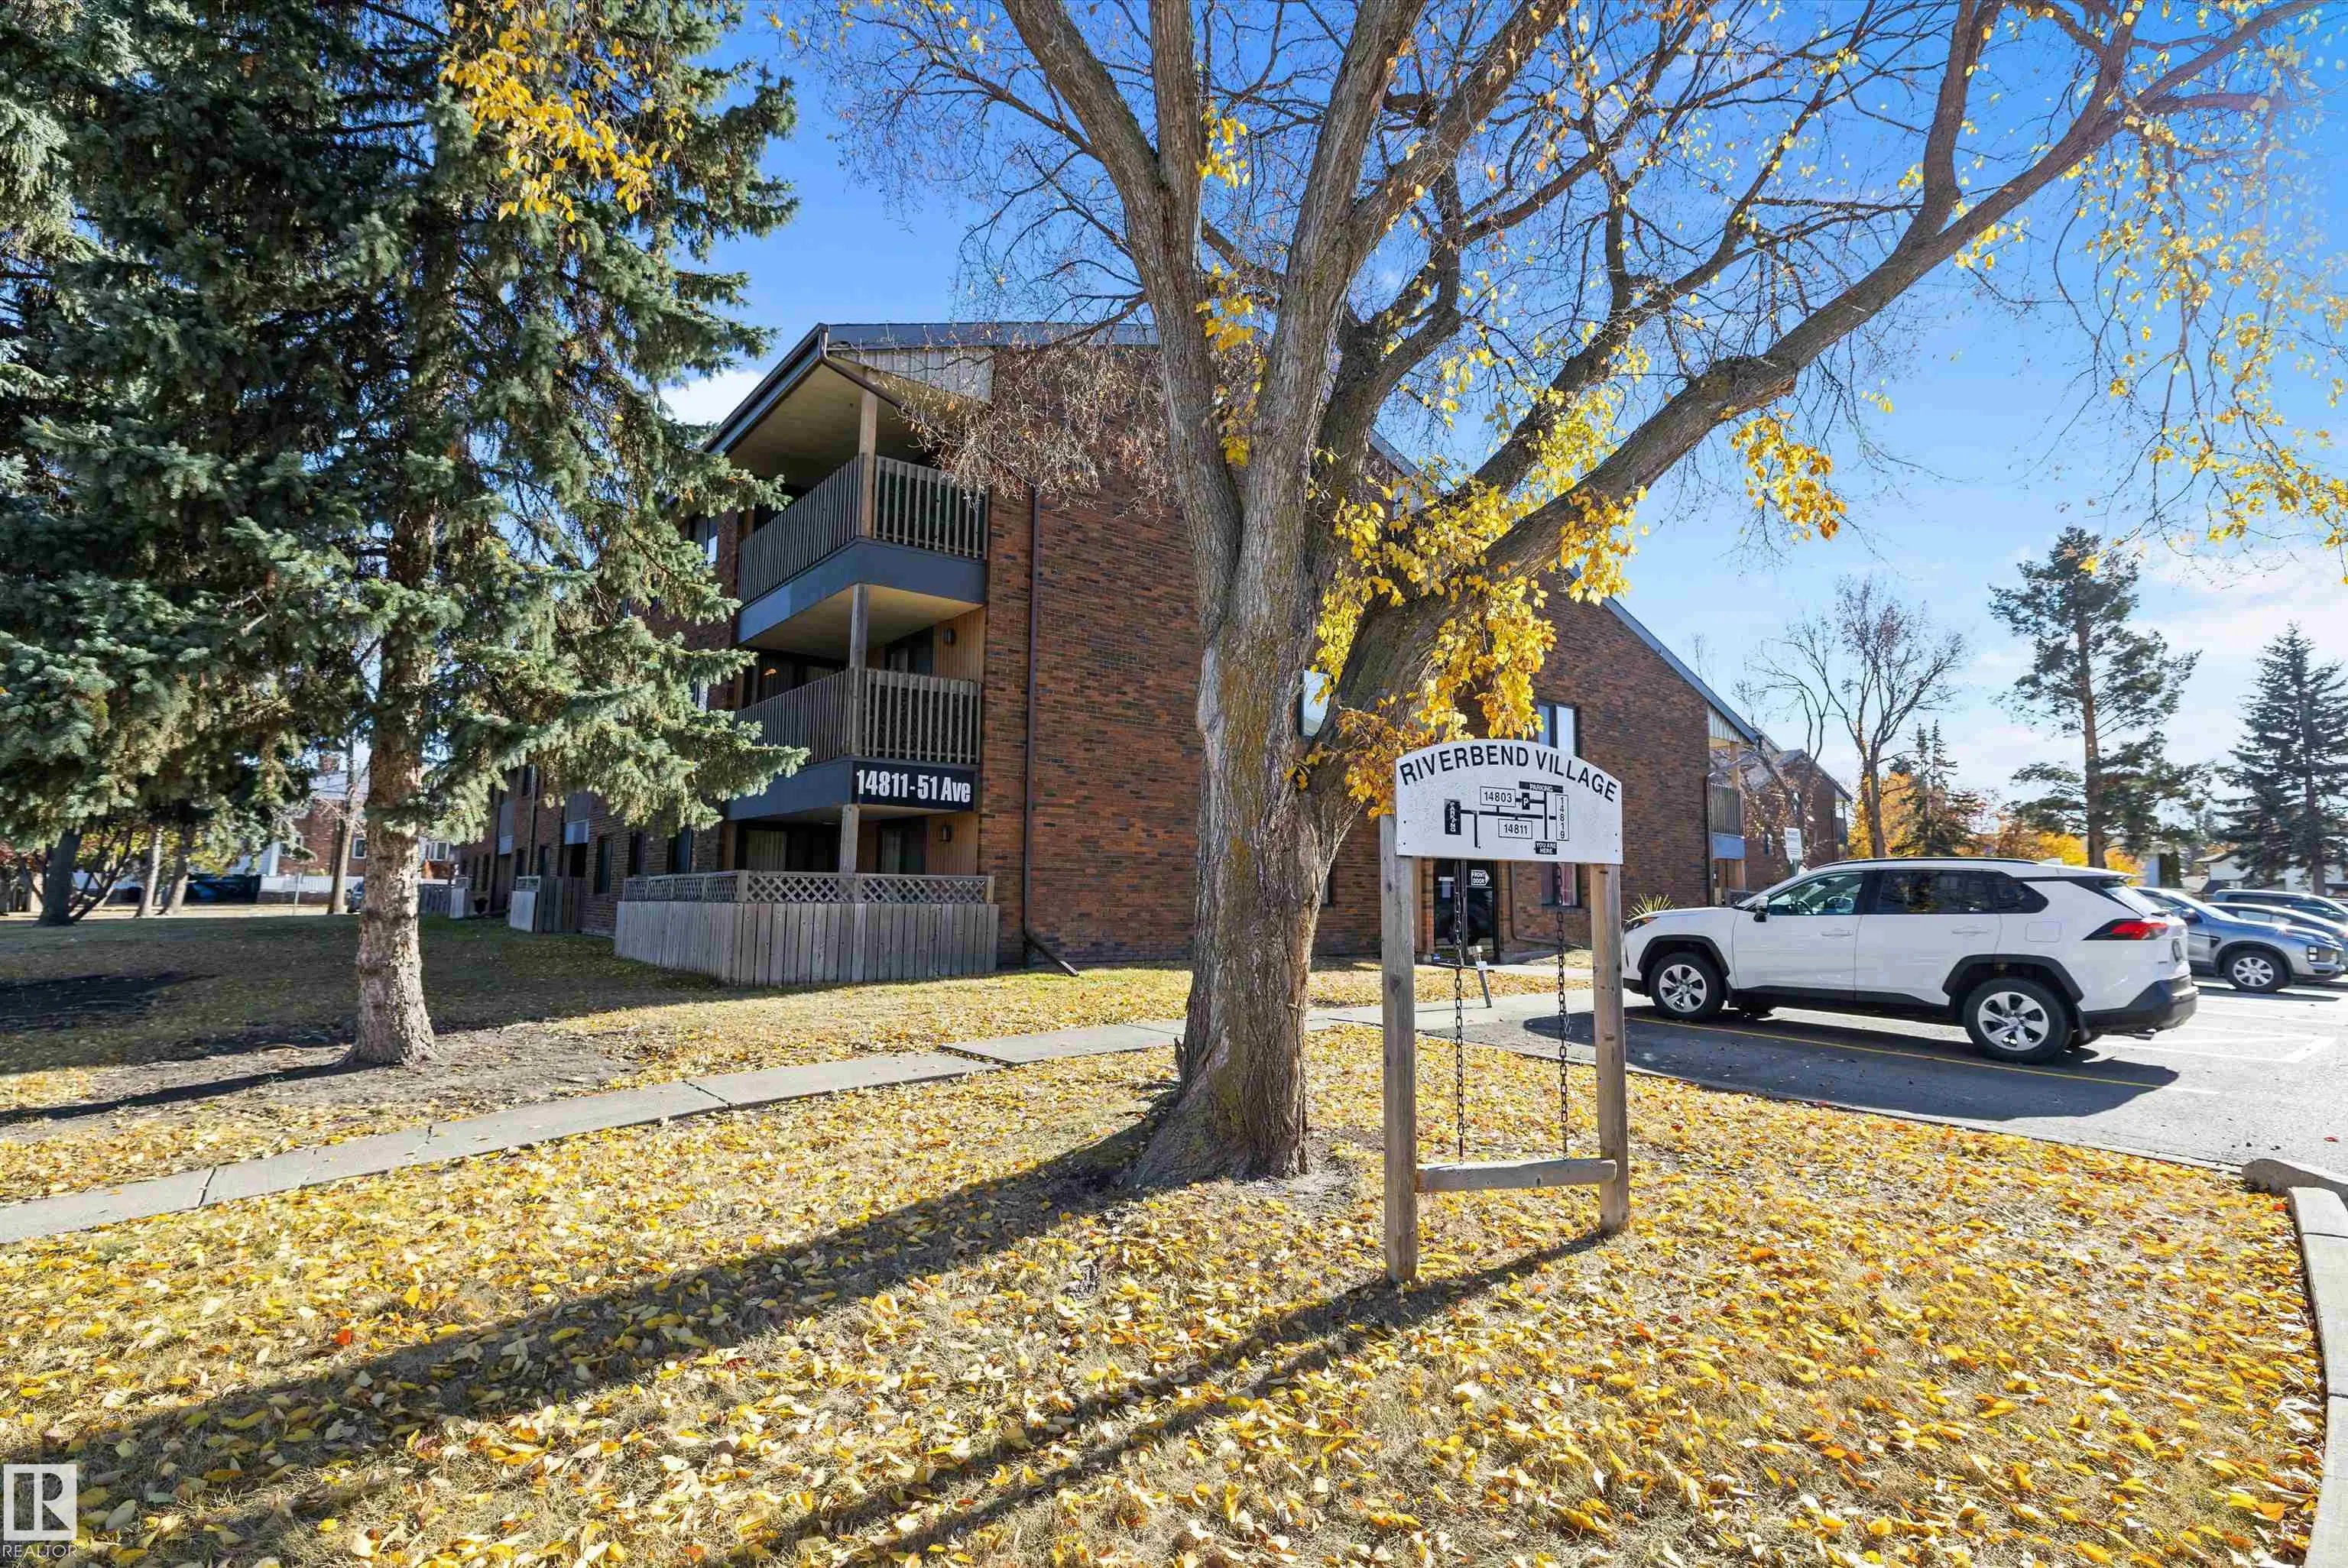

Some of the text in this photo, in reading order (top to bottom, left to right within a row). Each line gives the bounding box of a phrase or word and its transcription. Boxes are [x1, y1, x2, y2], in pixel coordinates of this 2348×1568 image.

[1399, 745, 1618, 802] RIVERBEND VILLAGE
[857, 769, 971, 803] 14811-51 Ave
[1529, 783, 1554, 792] PARKING
[1484, 791, 1513, 803] 14803
[1523, 797, 1529, 806] P
[1503, 823, 1528, 835] 14811
